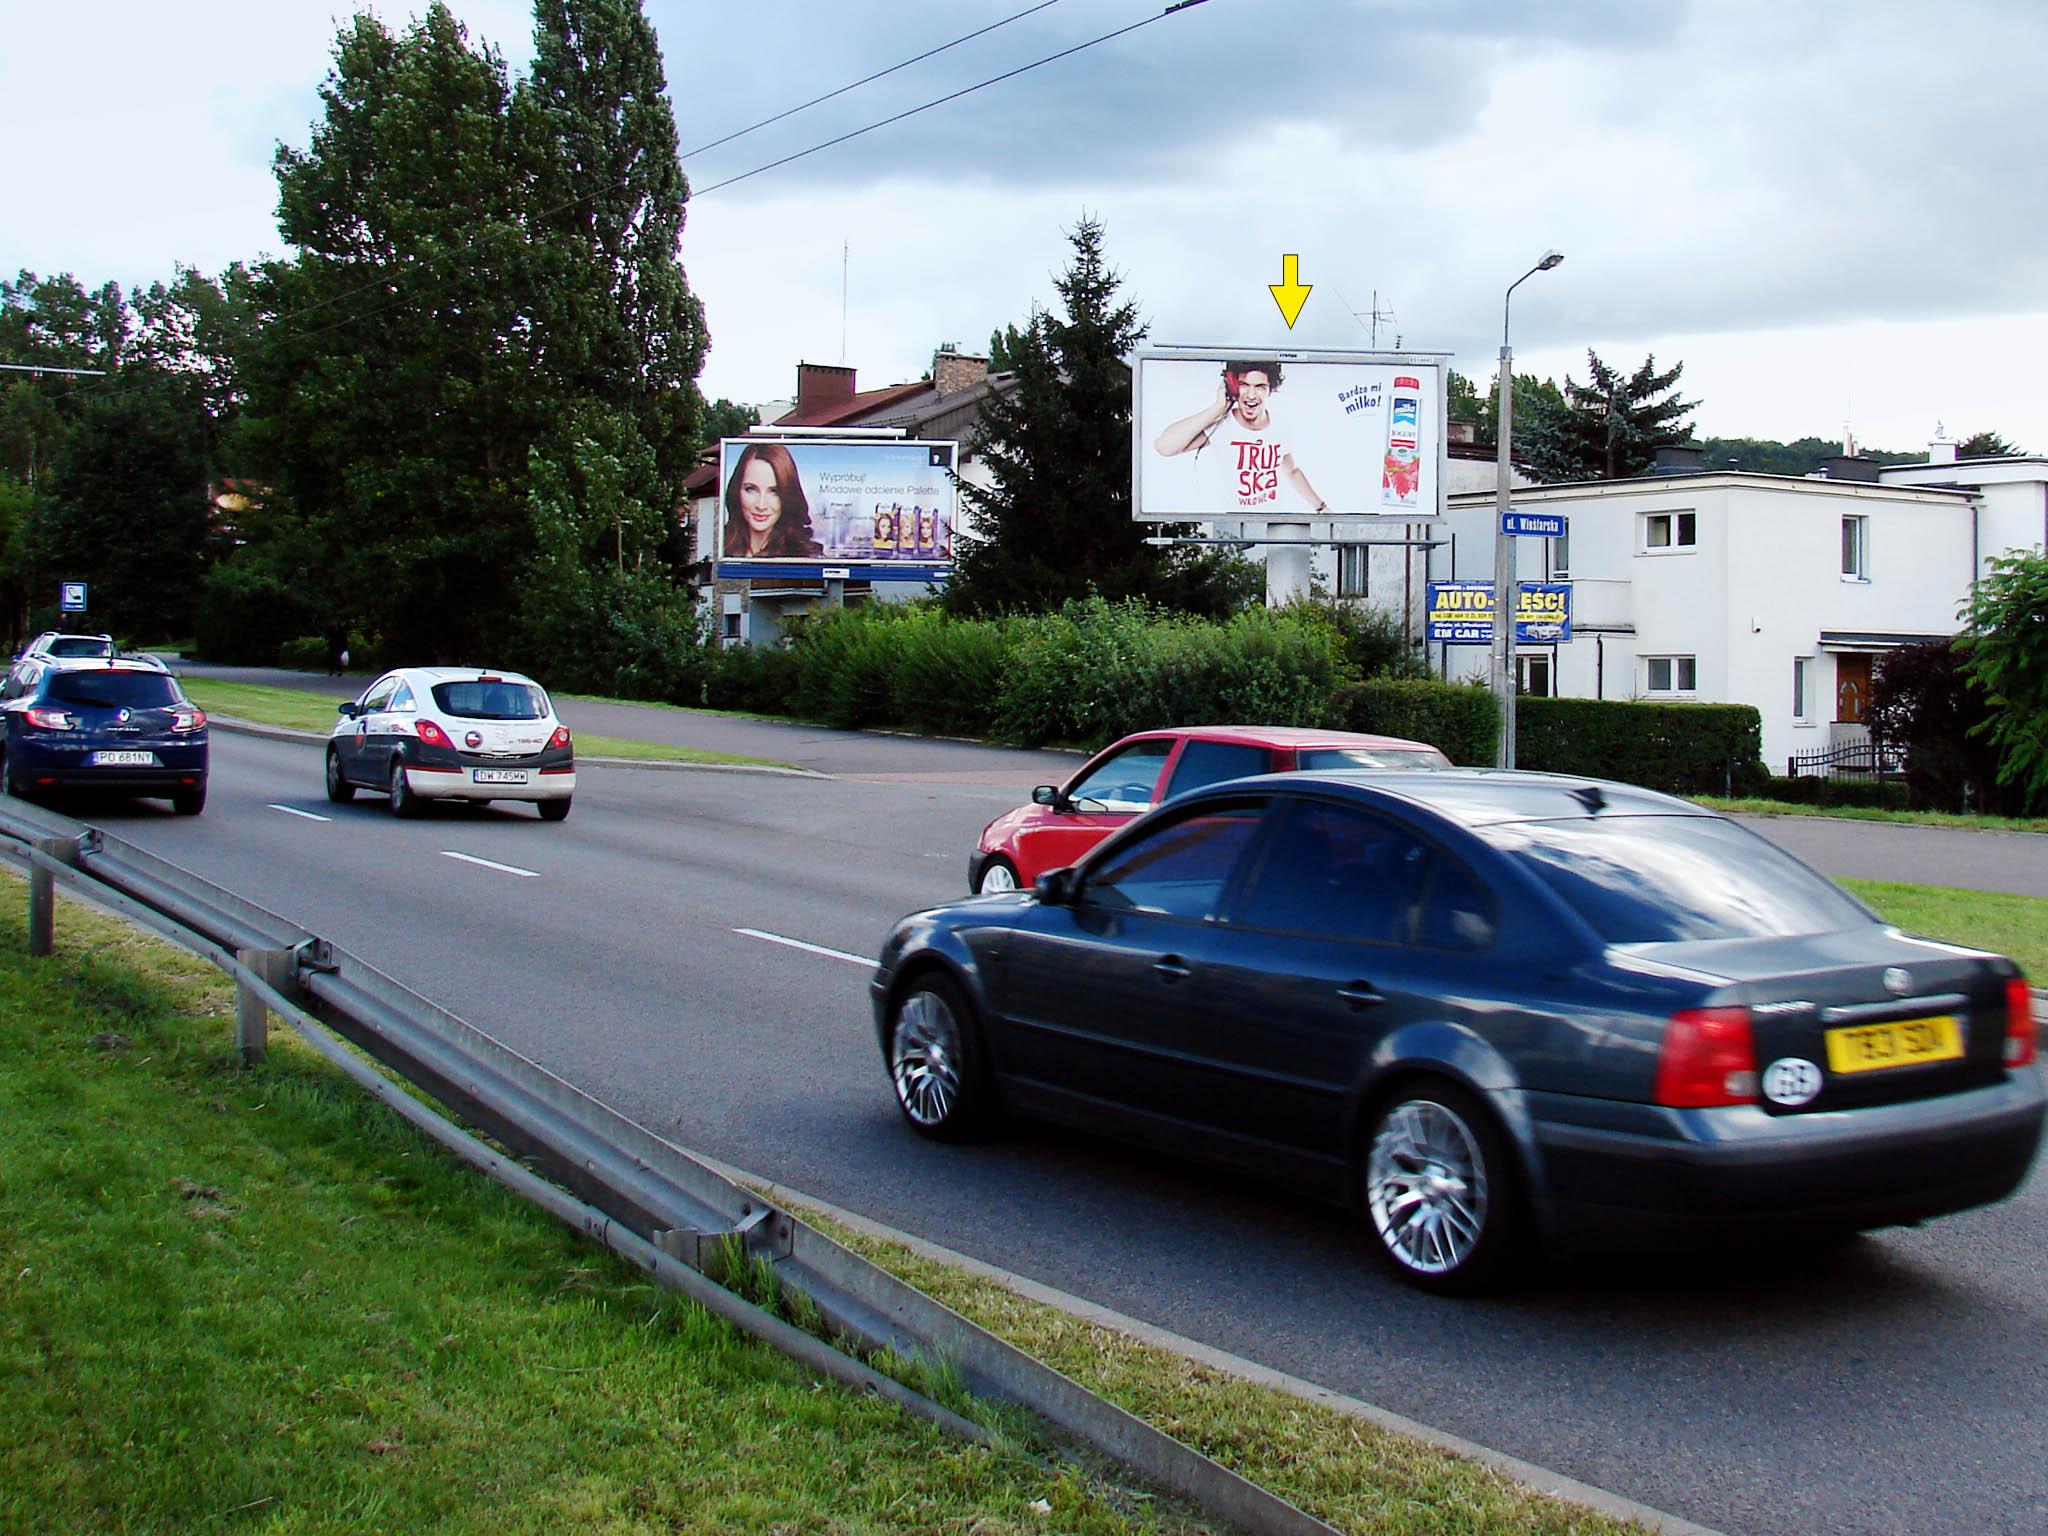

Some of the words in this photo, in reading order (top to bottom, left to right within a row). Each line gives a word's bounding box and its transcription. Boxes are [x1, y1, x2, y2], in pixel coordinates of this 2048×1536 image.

[1338, 384, 1368, 402] Bardzo
[1370, 382, 1382, 392] mi
[1345, 394, 1382, 414] milko!
[1230, 439, 1281, 471] TRUE
[819, 471, 867, 483] Wypróbuj!
[819, 484, 863, 494] Miodowe
[865, 484, 905, 495] odcienie
[907, 485, 940, 495] Palette
[1506, 517, 1516, 530] ul.
[1455, 628, 1480, 638] CAR
[99, 752, 115, 762] PO
[119, 752, 151, 762] 681NY
[480, 771, 494, 781] DW
